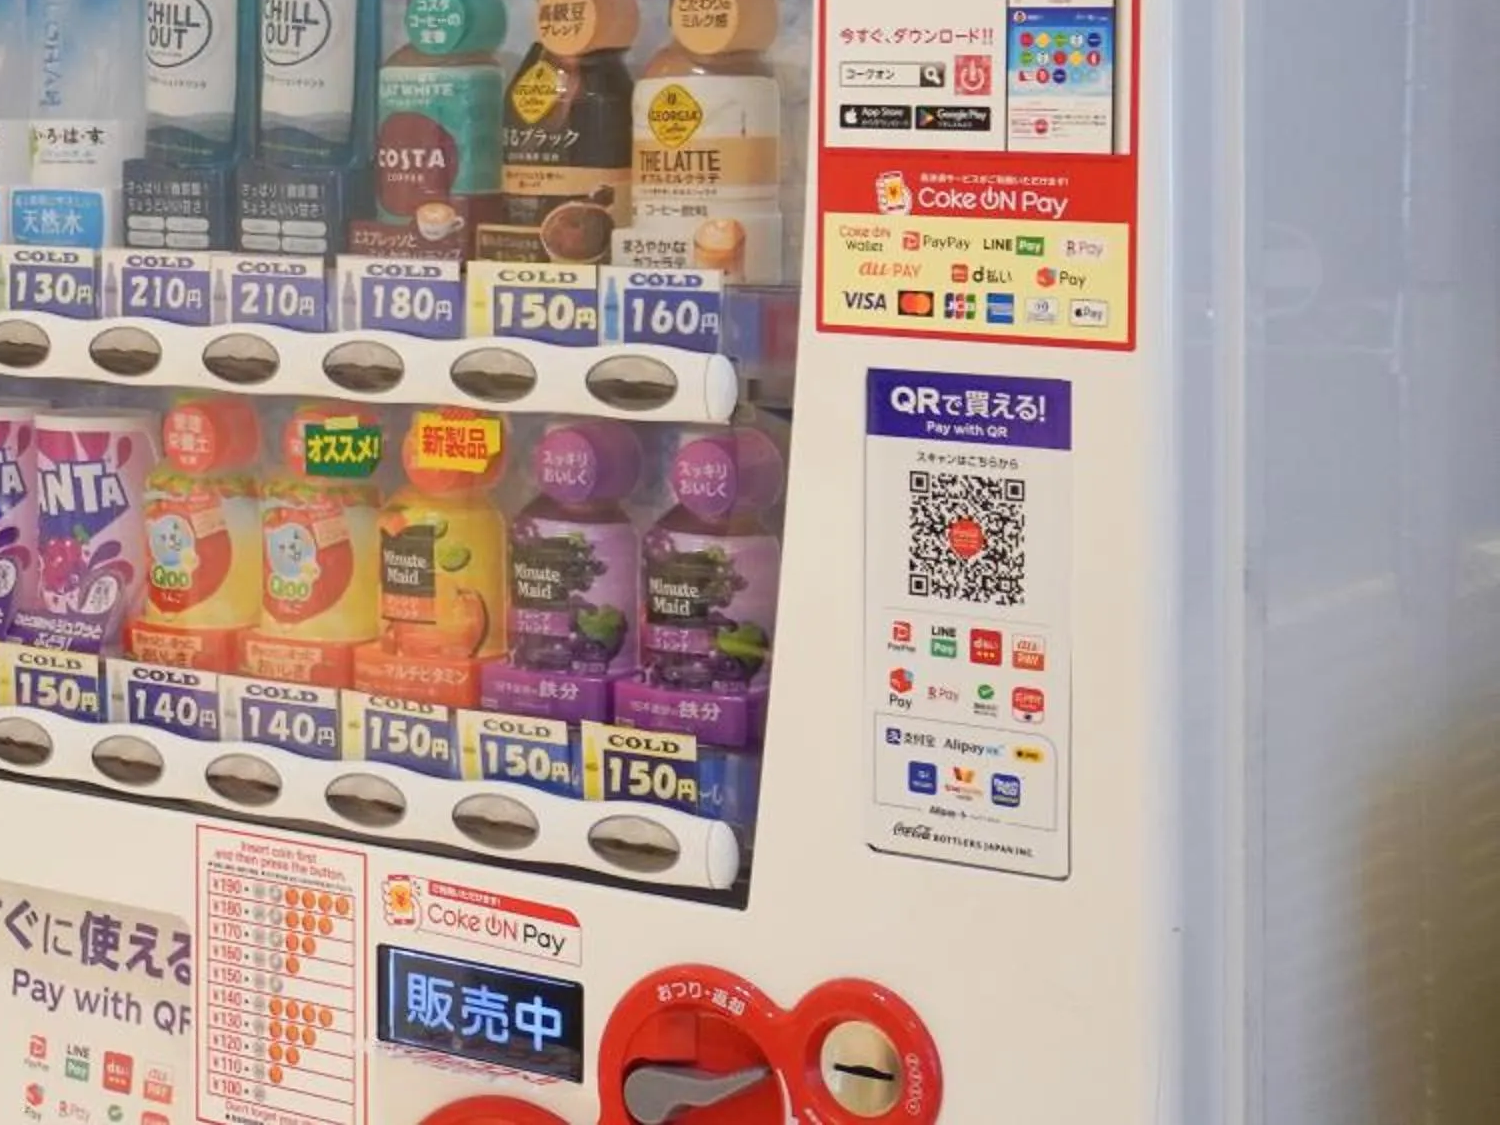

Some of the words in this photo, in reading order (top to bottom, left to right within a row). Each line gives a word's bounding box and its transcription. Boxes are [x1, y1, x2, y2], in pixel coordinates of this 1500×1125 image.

[265, 24, 308, 48] OUT
[839, 27, 994, 47] 今すぐ、ダウンロード!!
[845, 68, 896, 80] コークオン
[861, 108, 881, 119] App
[882, 107, 906, 117] Store
[936, 109, 965, 122] Google
[966, 110, 987, 122] Play
[378, 148, 447, 170] COSTA
[639, 150, 662, 174] THE
[663, 150, 722, 174] LATTE
[918, 186, 977, 210] Coke
[980, 186, 1017, 211] ON
[1021, 191, 1069, 219] Pay
[21, 210, 85, 234] 天然水
[922, 235, 972, 251] PayPay
[983, 238, 1013, 251] LINE
[1019, 240, 1043, 254] Pay
[236, 260, 308, 276] COLD
[14, 271, 93, 306] 130円
[1059, 271, 1087, 290] Pay
[130, 274, 203, 310] 210円
[240, 280, 316, 318] 210円
[842, 290, 888, 312] VISA
[371, 285, 454, 322] 180円
[499, 292, 598, 332] 150円
[630, 296, 720, 336] 160円
[890, 385, 1046, 423] QRで買える!
[926, 421, 952, 436] Pay
[954, 423, 985, 438] with
[986, 425, 1009, 438] QR
[307, 436, 380, 463] オススメ!
[422, 425, 489, 462] 新製品
[916, 451, 1020, 471] スキャンはこちらから
[542, 468, 588, 486] おいしく
[678, 478, 728, 497] おいしく
[387, 567, 420, 586] Maid
[514, 562, 561, 583] Minute
[517, 580, 553, 600] Maid
[649, 576, 700, 598] Minute
[652, 595, 691, 616] Maid
[930, 625, 957, 638] LINE
[18, 673, 98, 712] 150円
[889, 694, 913, 710] Pay
[135, 690, 217, 729] 140円
[369, 695, 434, 714] COLD
[249, 706, 335, 747] 140円
[369, 715, 449, 761] 150円
[485, 741, 571, 784] 150円
[609, 759, 697, 802] 150円
[932, 834, 983, 850] BOTTLERS
[983, 839, 1014, 856] JAPAN
[428, 903, 480, 932] Coke
[485, 914, 518, 941] ON
[523, 923, 566, 956] Pay
[12, 967, 65, 1013] Pay
[73, 987, 143, 1026] with
[406, 971, 563, 1053] 販売中
